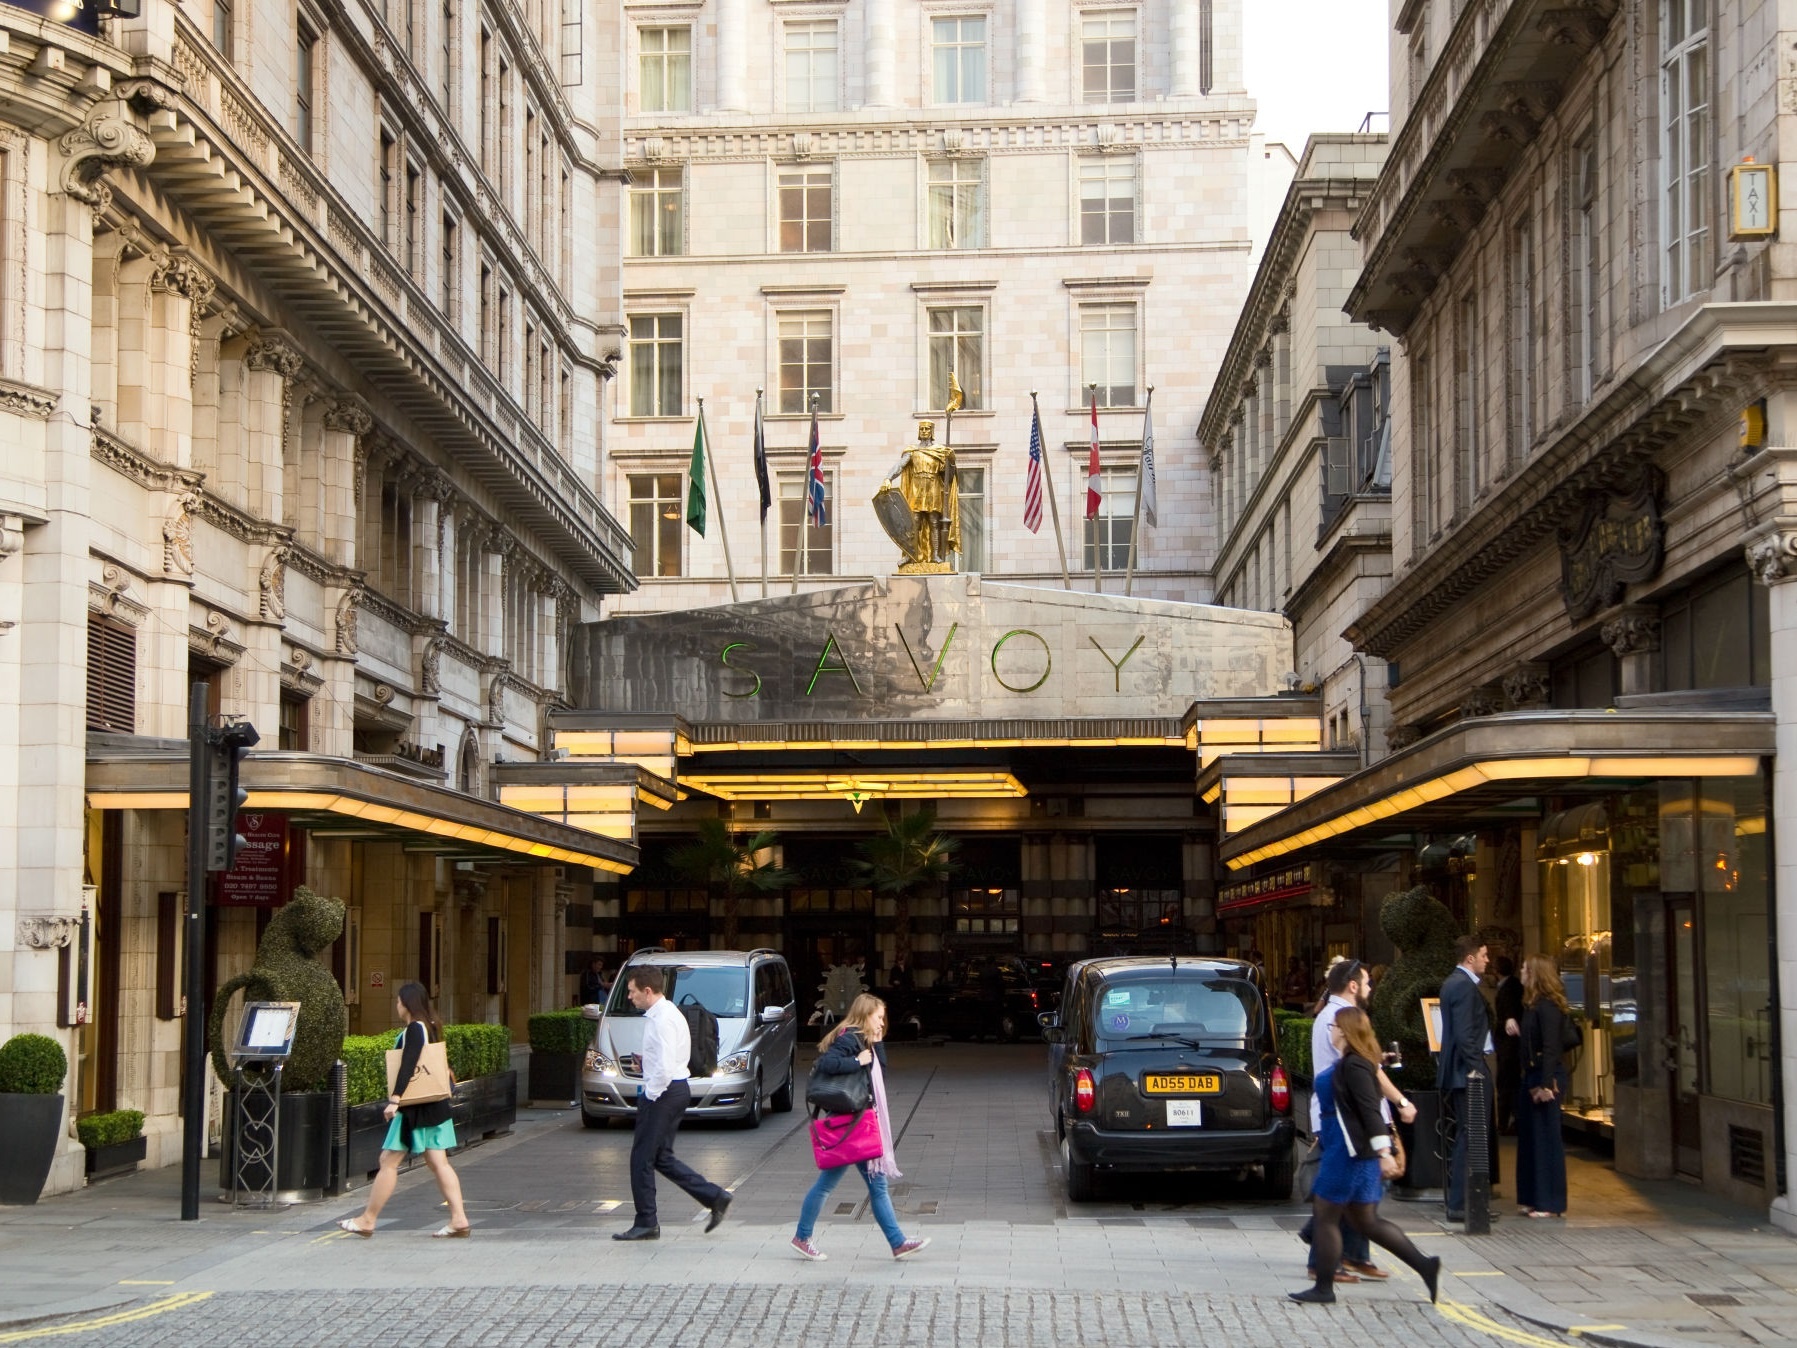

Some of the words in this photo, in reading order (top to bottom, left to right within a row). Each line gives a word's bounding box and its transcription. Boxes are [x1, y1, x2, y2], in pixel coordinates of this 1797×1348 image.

[1747, 173, 1760, 226] TAXI
[720, 620, 1146, 699] SAVOY
[246, 841, 280, 851] ssage
[1116, 1016, 1126, 1024] M
[1152, 1077, 1185, 1089] AD55
[1188, 1077, 1213, 1089] DAB
